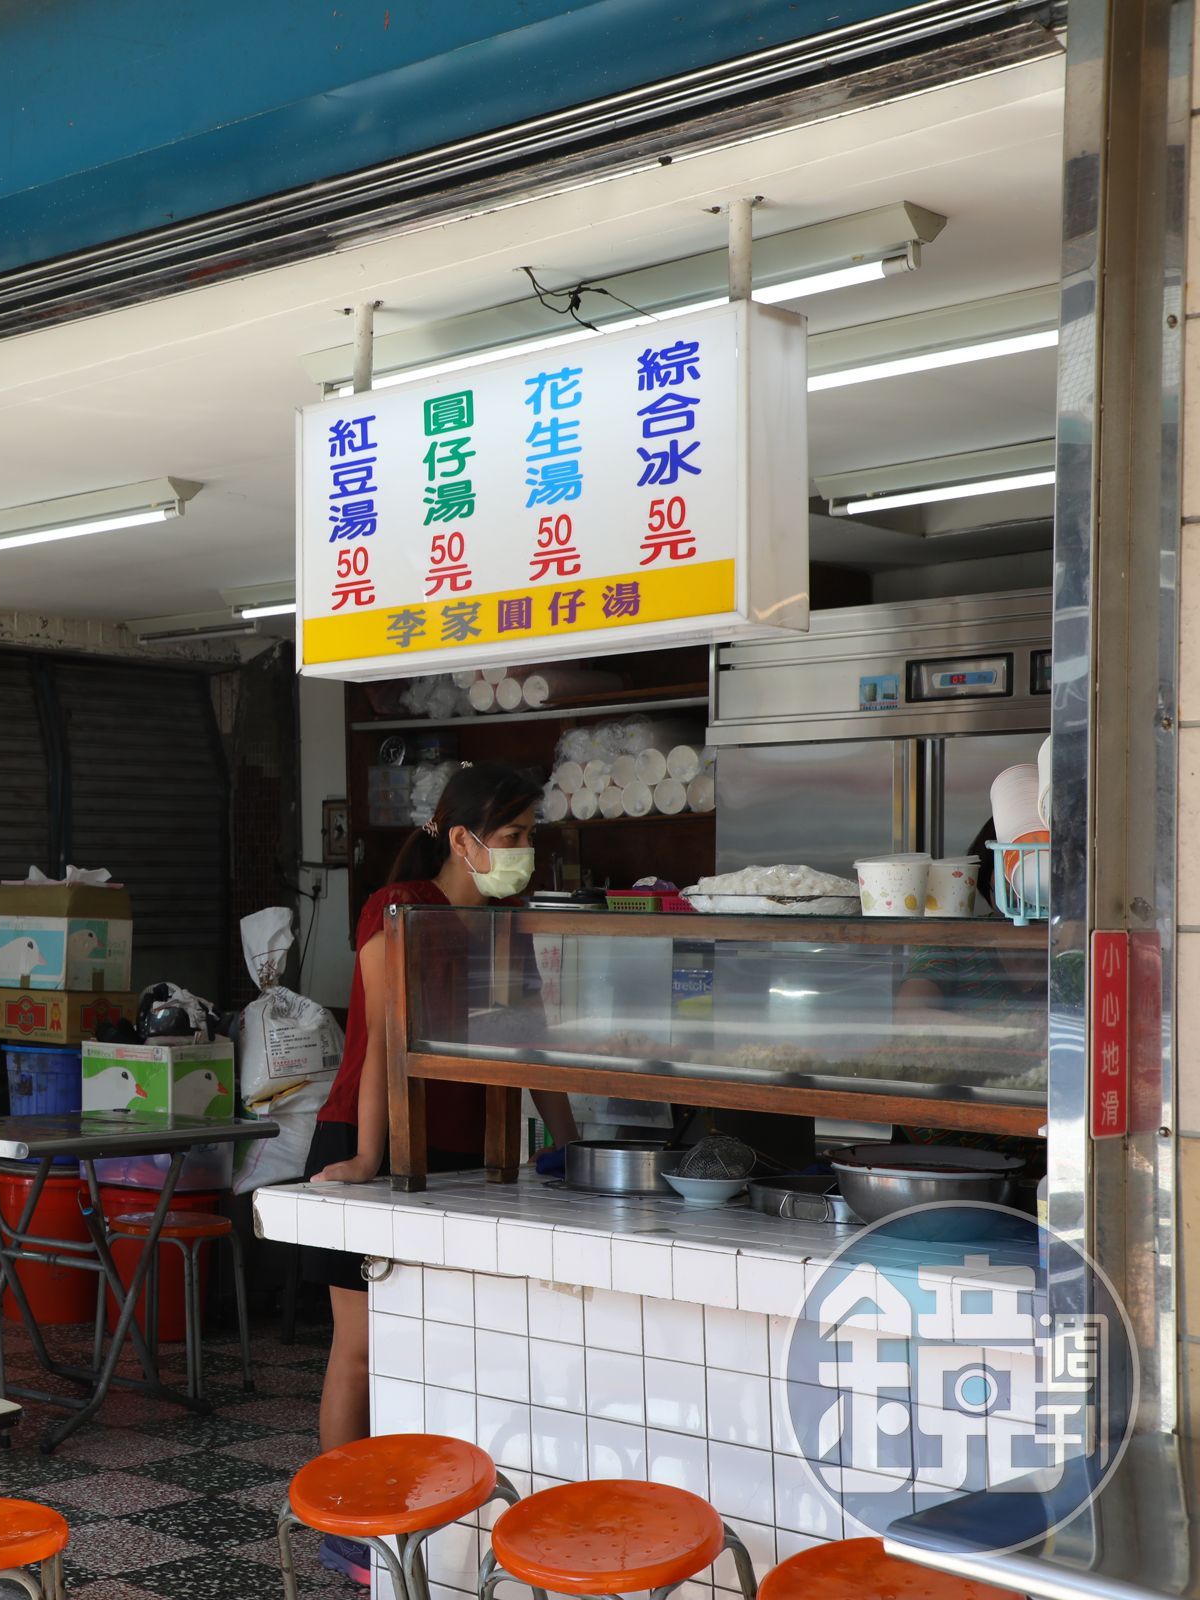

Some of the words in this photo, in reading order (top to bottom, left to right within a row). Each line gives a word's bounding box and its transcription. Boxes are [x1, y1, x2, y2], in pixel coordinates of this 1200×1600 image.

[328, 415, 378, 543] 紅豆湯
[422, 389, 477, 526] 圓仔湯
[524, 367, 584, 509] 花生湯
[636, 340, 702, 487] 綜合冰
[387, 581, 641, 648] 李家圓仔湯
[1100, 942, 1121, 1127] 小心地滑
